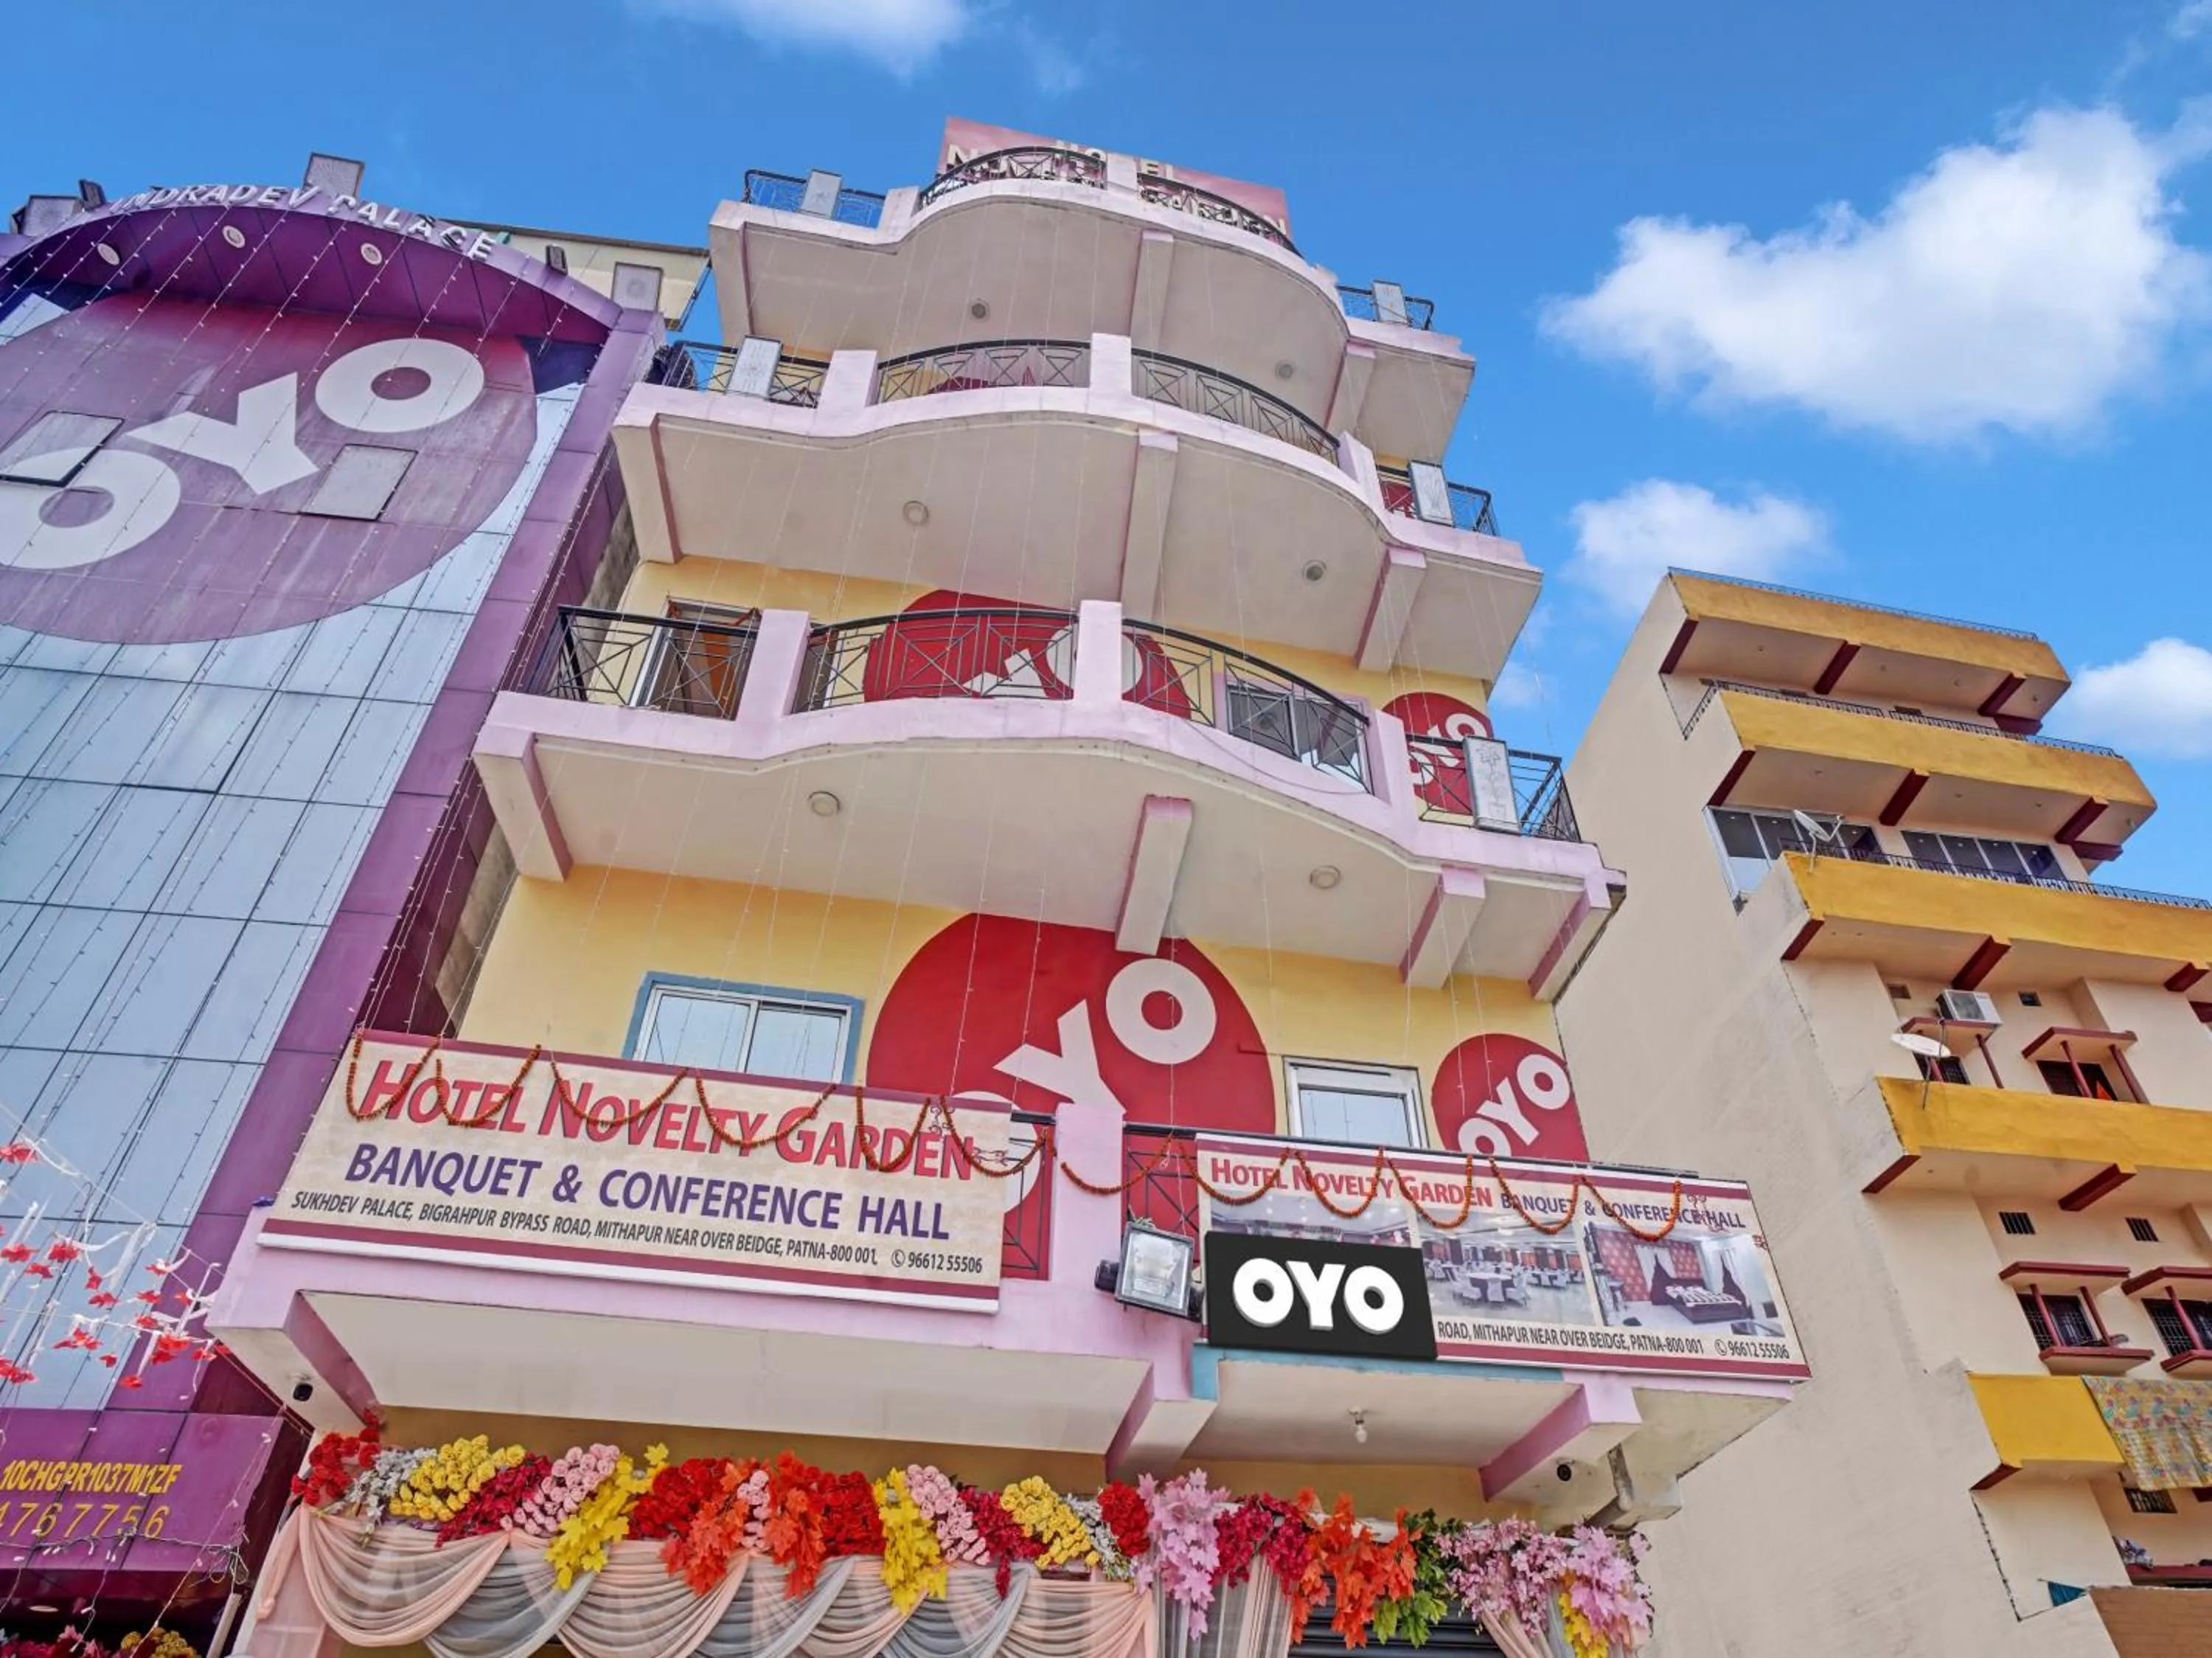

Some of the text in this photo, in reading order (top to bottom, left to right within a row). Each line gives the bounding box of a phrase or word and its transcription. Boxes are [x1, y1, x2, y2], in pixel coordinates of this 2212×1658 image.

[358, 1060, 974, 1181] HOTEL NOVELTY GARDEN
[1458, 1053, 1571, 1156] OYO
[291, 1191, 359, 1213] SUKHDEV
[360, 1198, 414, 1221] PALACE,
[419, 1203, 496, 1227] BIGRAHPUR
[500, 1210, 549, 1232] BYPASS
[552, 1217, 591, 1239] ROAD,
[594, 1221, 664, 1244] MITHAPUR
[664, 1229, 698, 1247] NEAR
[700, 1231, 734, 1250] OVER
[345, 1143, 950, 1240] BANQUET & CONFERENCE HALL
[1211, 1157, 1288, 1190] HOTEL
[1292, 1165, 1394, 1199] NOVELTY
[1585, 1200, 1596, 1216] &
[1602, 1203, 1701, 1225] CONFERECE
[1708, 1208, 1747, 1229] HALL
[1232, 1258, 1405, 1335] OYO
[1473, 1323, 1528, 1344] MITHAPUR
[1530, 1328, 1558, 1346] NEAR
[1559, 1330, 1588, 1347] OVER
